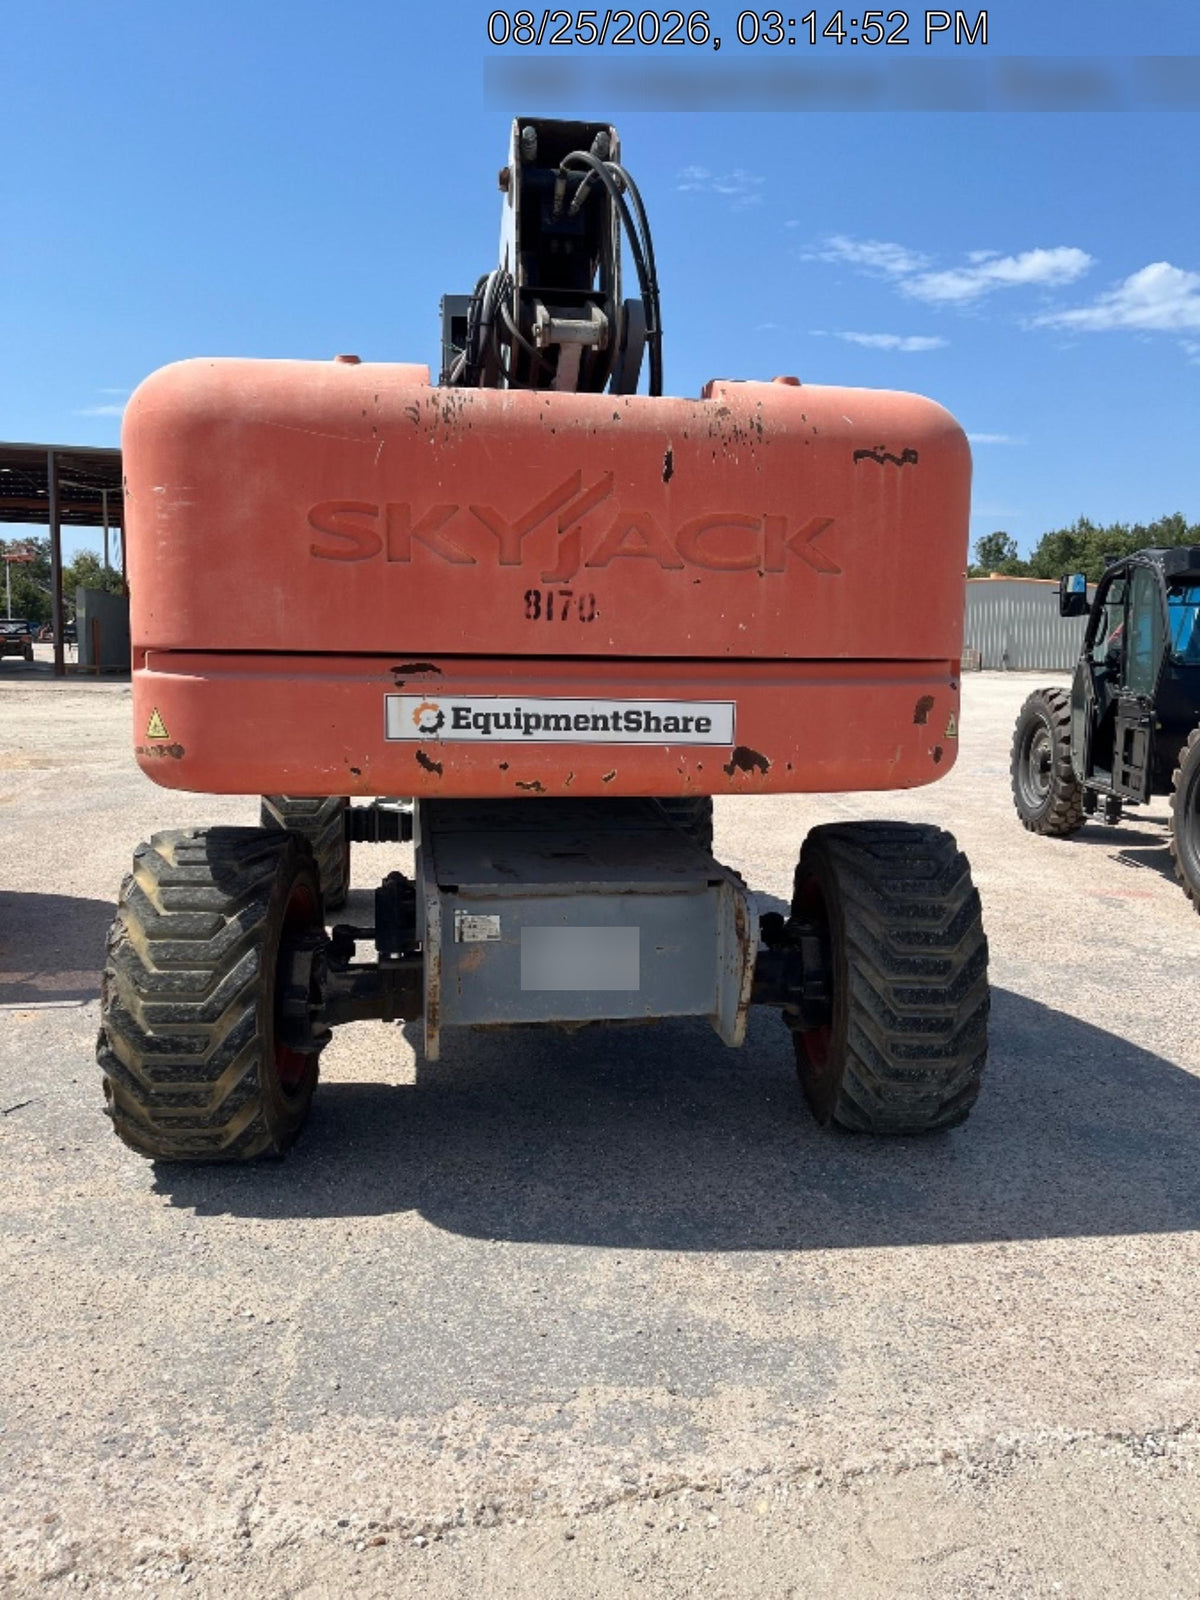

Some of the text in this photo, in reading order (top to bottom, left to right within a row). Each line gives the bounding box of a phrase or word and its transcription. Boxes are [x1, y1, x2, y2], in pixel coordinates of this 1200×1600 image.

[308, 469, 842, 583] SKYJACK
[524, 588, 597, 622] 8170
[451, 706, 712, 737] EquipmentShare
